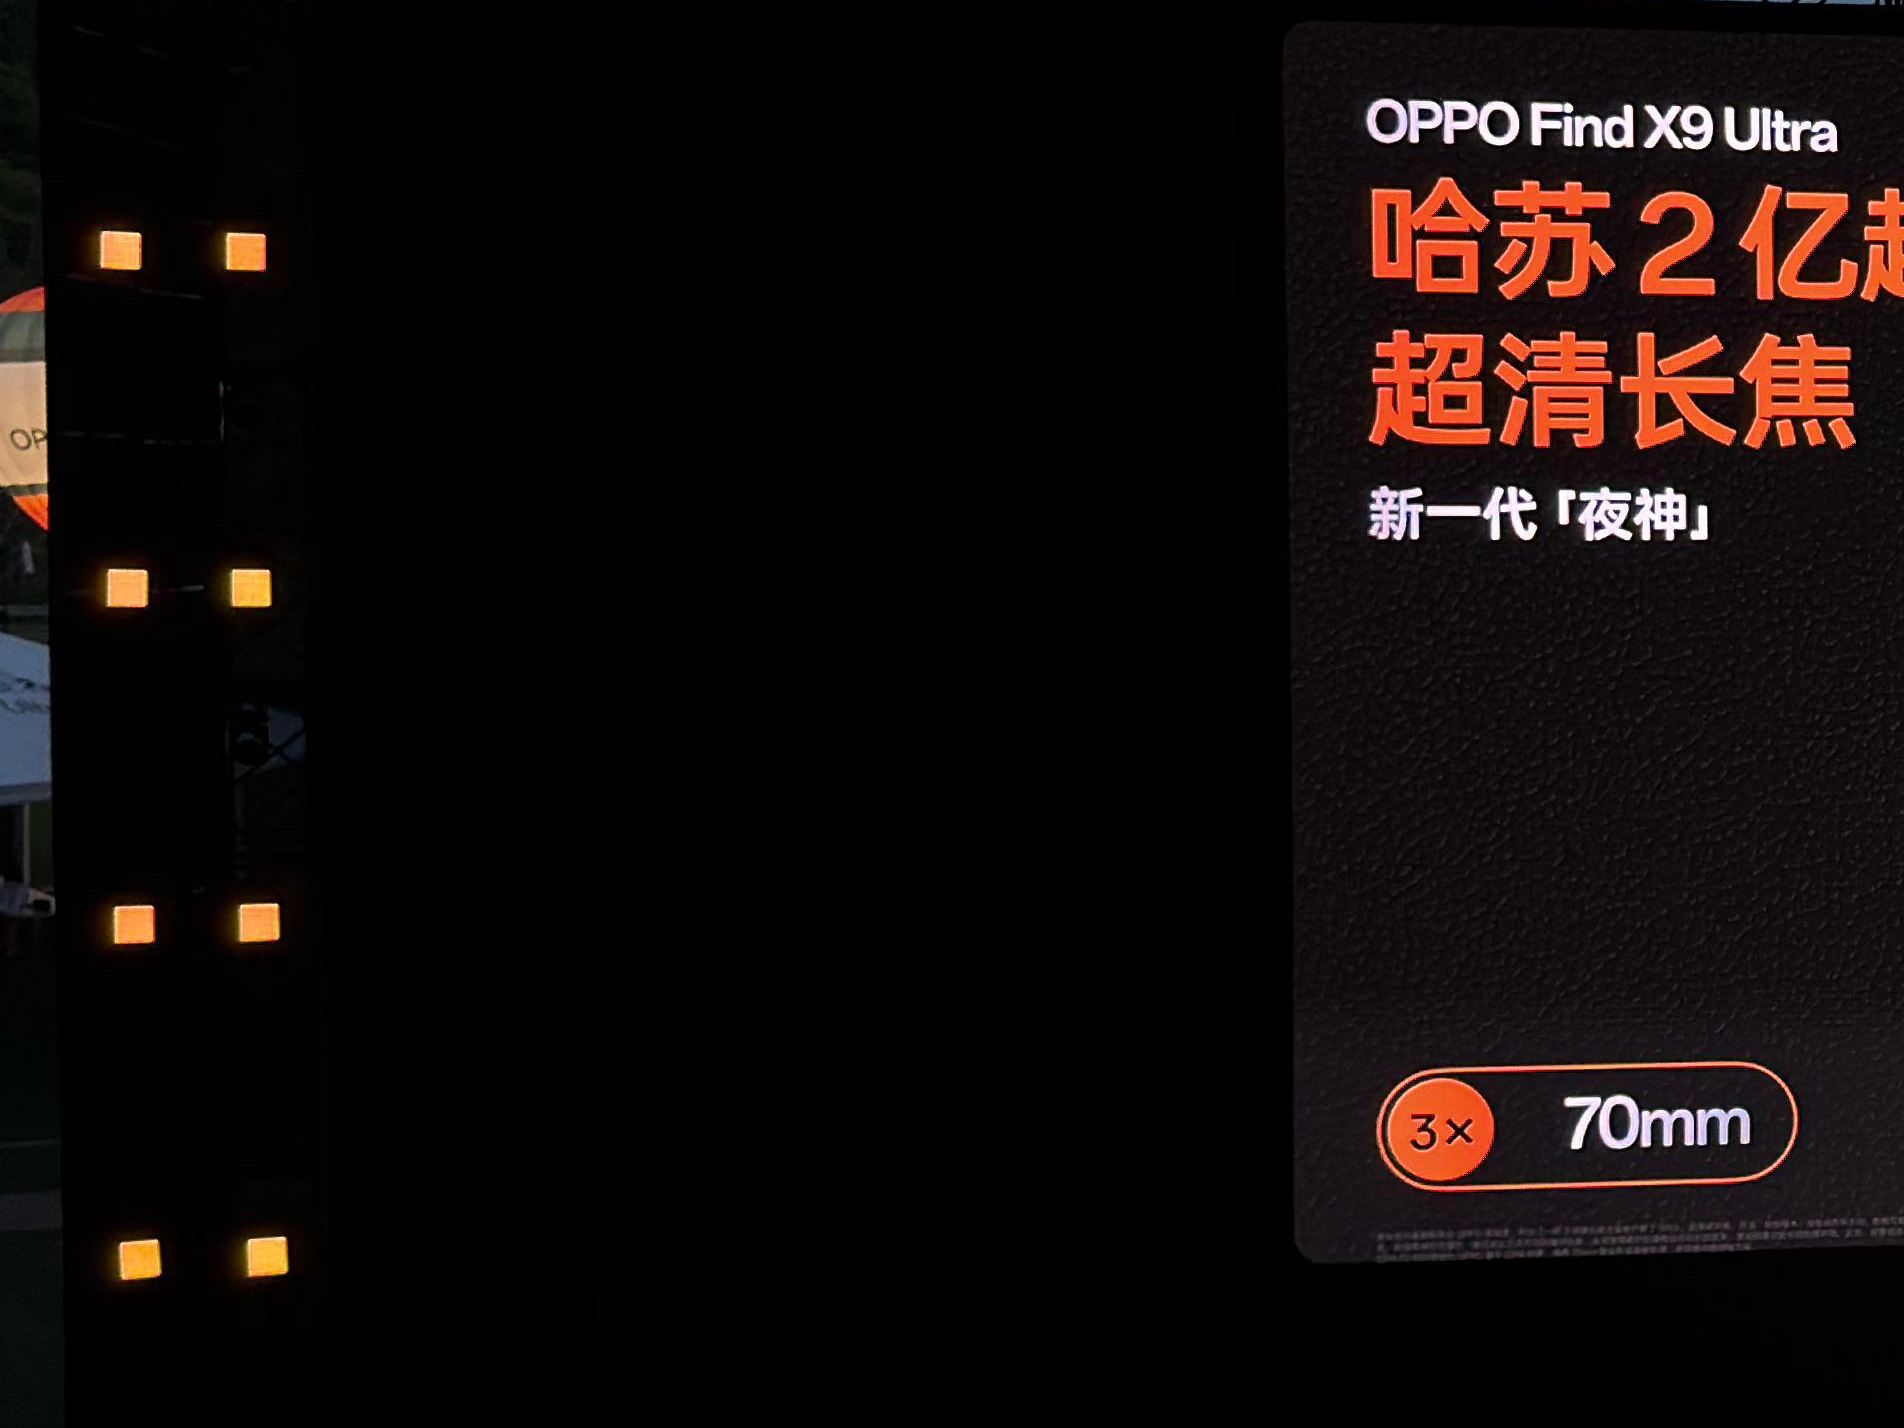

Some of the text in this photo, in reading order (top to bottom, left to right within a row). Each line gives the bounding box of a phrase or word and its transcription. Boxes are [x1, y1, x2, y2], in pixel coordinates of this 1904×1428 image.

[1366, 98, 1839, 153] OPPO Find X9 Ultra
[1371, 177, 1614, 302] 哈苏
[1638, 192, 1716, 296] 2
[1368, 329, 1857, 451] 超清长焦
[1562, 1093, 1752, 1151] 70mm
